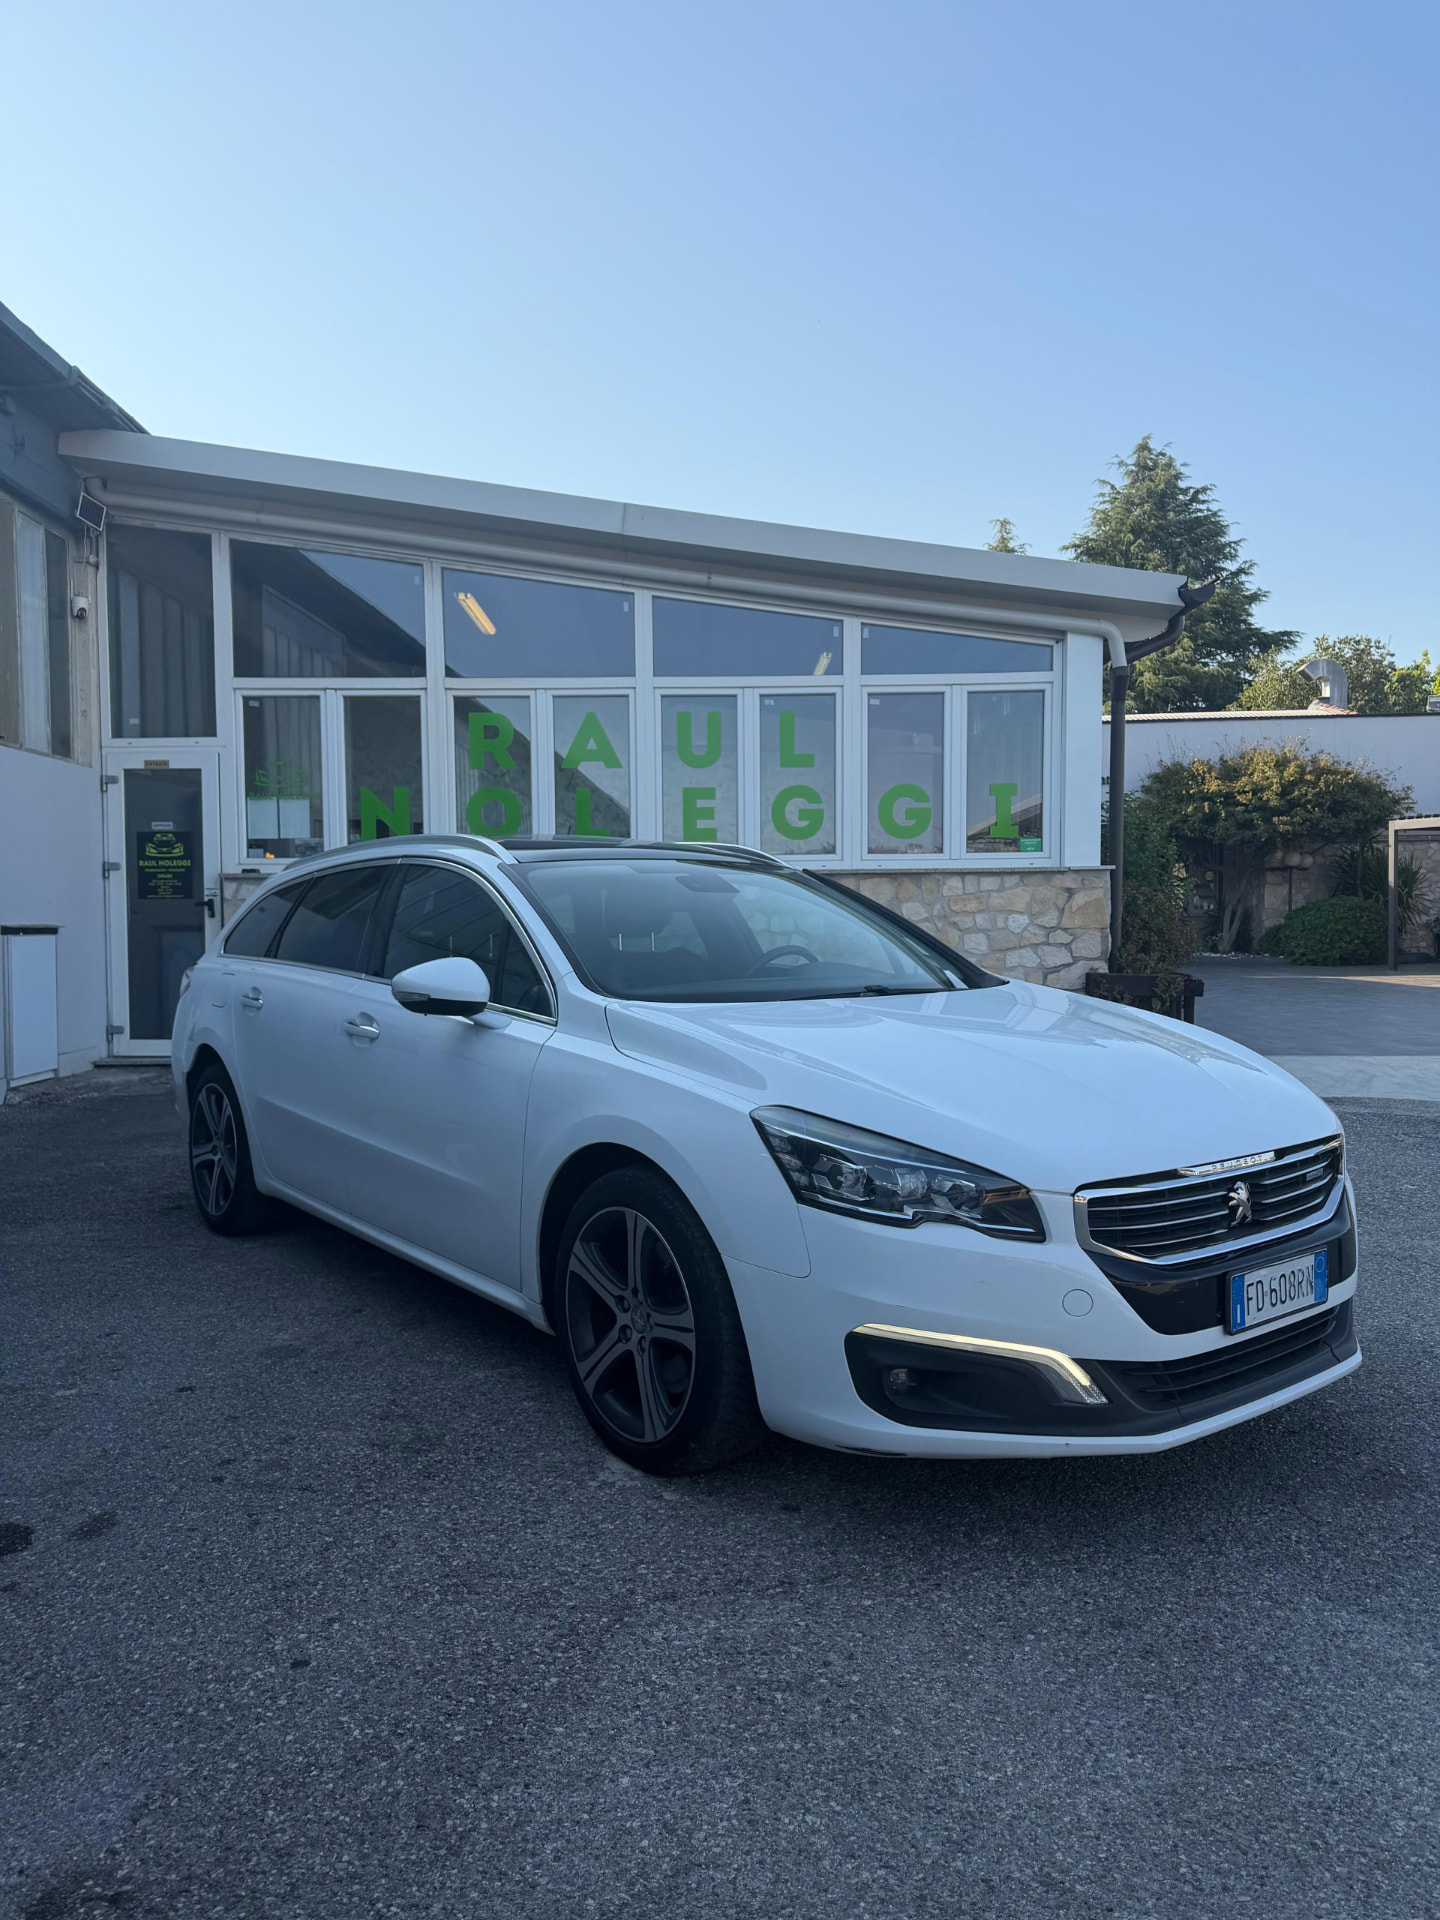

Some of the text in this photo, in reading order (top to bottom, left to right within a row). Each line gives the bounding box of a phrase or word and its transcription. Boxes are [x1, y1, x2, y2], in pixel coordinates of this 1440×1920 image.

[467, 710, 815, 770] RAUL
[360, 783, 1019, 842] NOLEGGI
[138, 859, 191, 867] RAUL NOLEGGI
[1211, 1154, 1263, 1170] PEUGEOT
